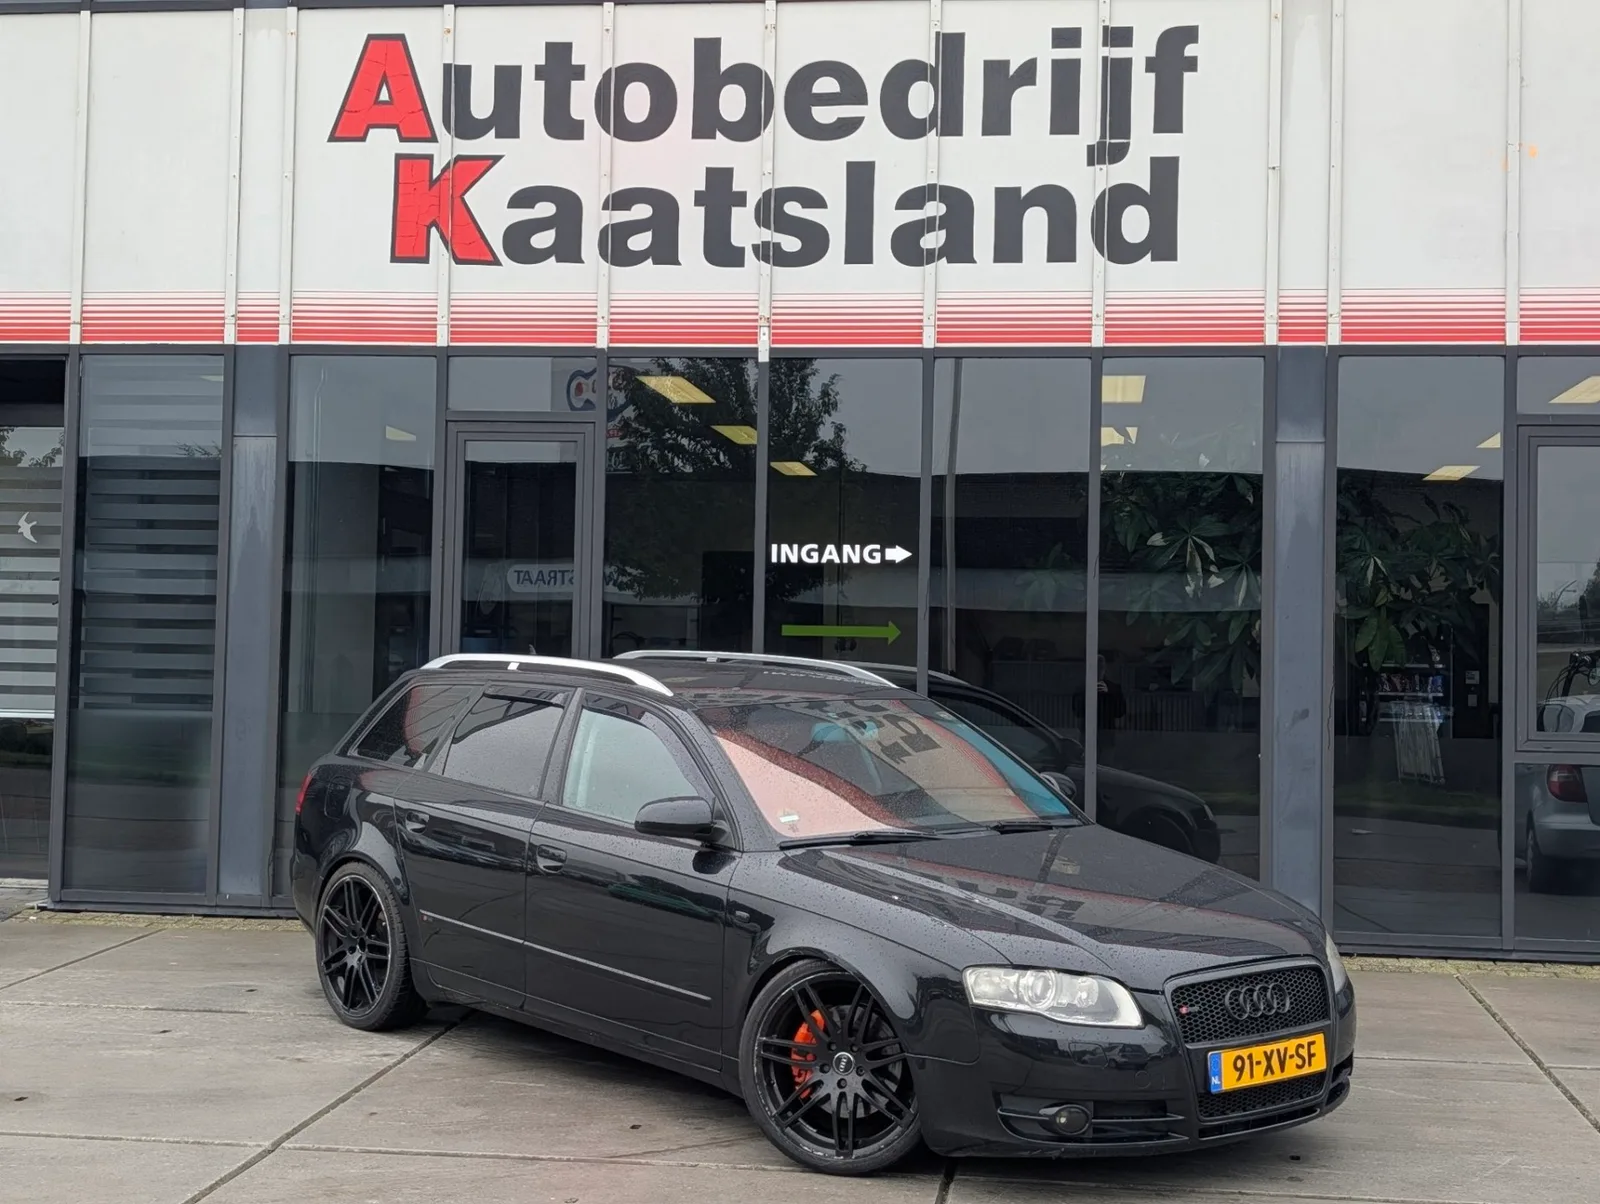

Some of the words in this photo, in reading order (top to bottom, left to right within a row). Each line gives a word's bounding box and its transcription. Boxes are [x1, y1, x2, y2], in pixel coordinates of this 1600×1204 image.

[328, 25, 1199, 167] Autobedrijf
[390, 154, 1180, 267] Kaatsland
[771, 543, 881, 564] INGANG
[1211, 1076, 1222, 1086] NL
[1233, 1040, 1317, 1082] 91-XV-SF
